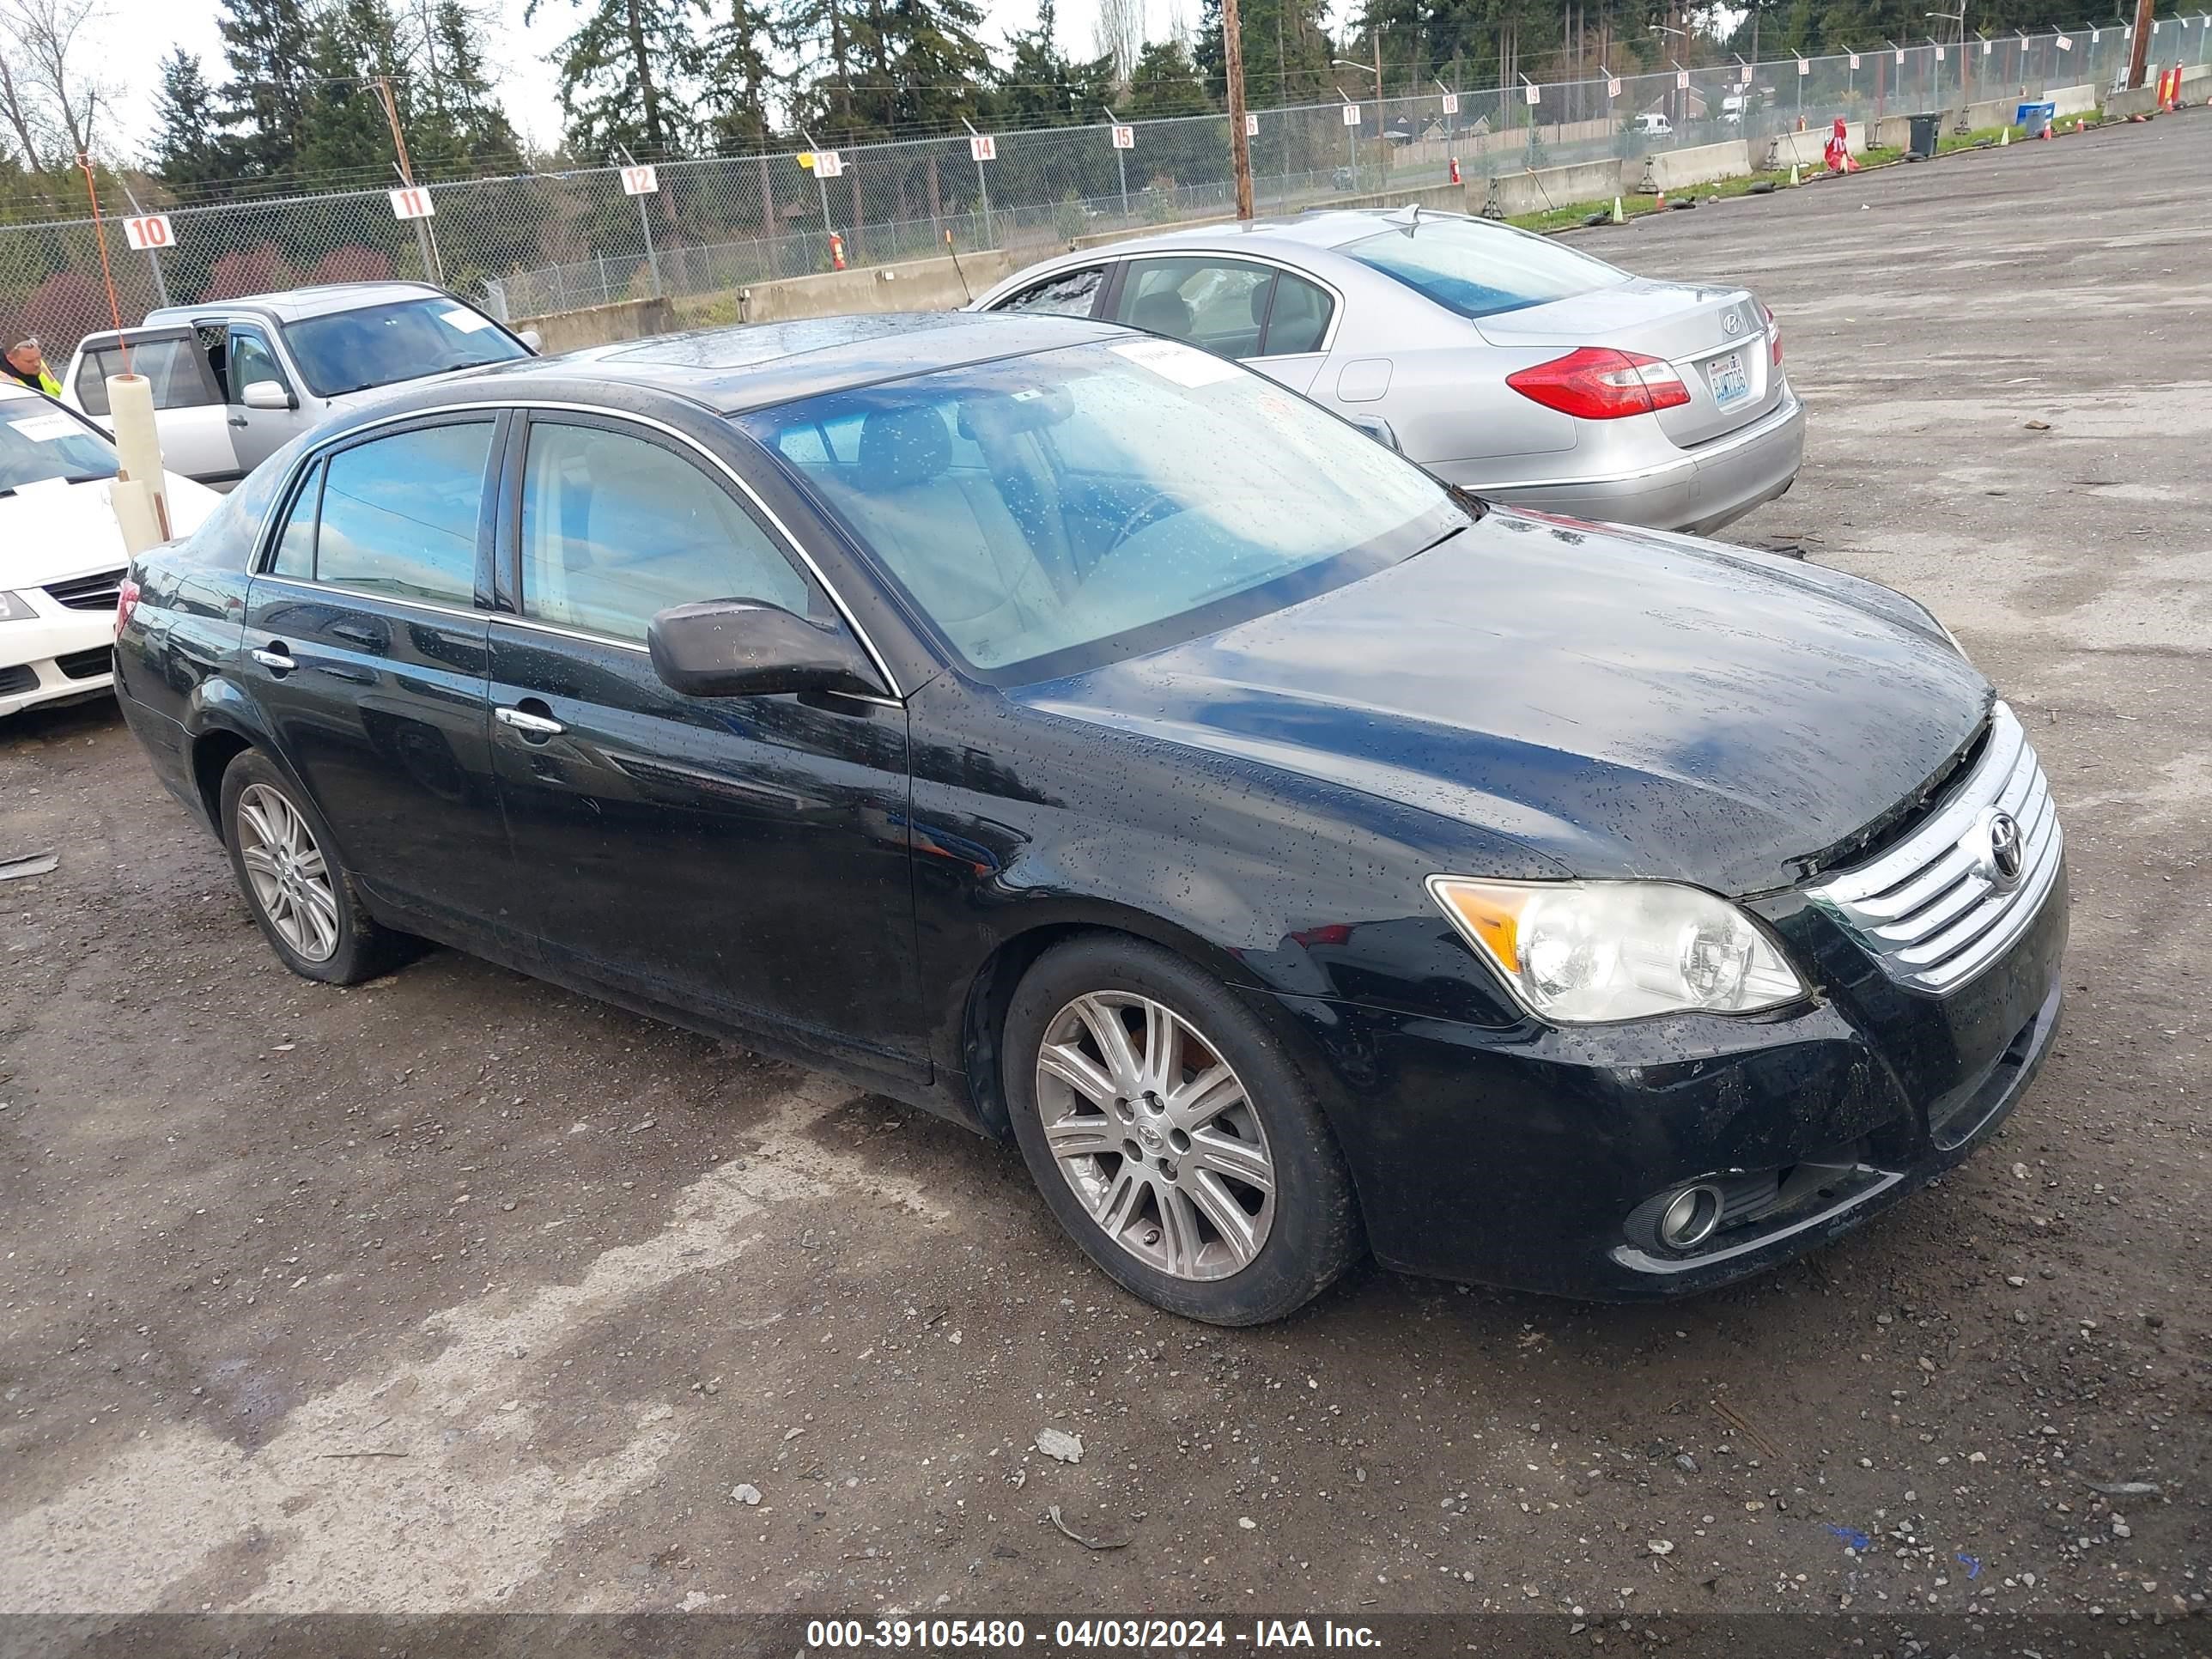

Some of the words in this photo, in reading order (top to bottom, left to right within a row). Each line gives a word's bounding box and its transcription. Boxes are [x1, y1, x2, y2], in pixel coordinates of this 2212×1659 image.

[1679, 74, 1688, 88] 21
[1742, 68, 1751, 81] 22
[1528, 87, 1538, 102] 19
[1609, 79, 1620, 96] 20
[1444, 95, 1455, 112] 18
[1347, 106, 1357, 124] 17
[1116, 128, 1130, 146] 15
[975, 137, 991, 158] 14
[817, 154, 836, 175] 13
[627, 167, 652, 192] 12
[400, 191, 423, 216] 11
[131, 217, 167, 246] 10
